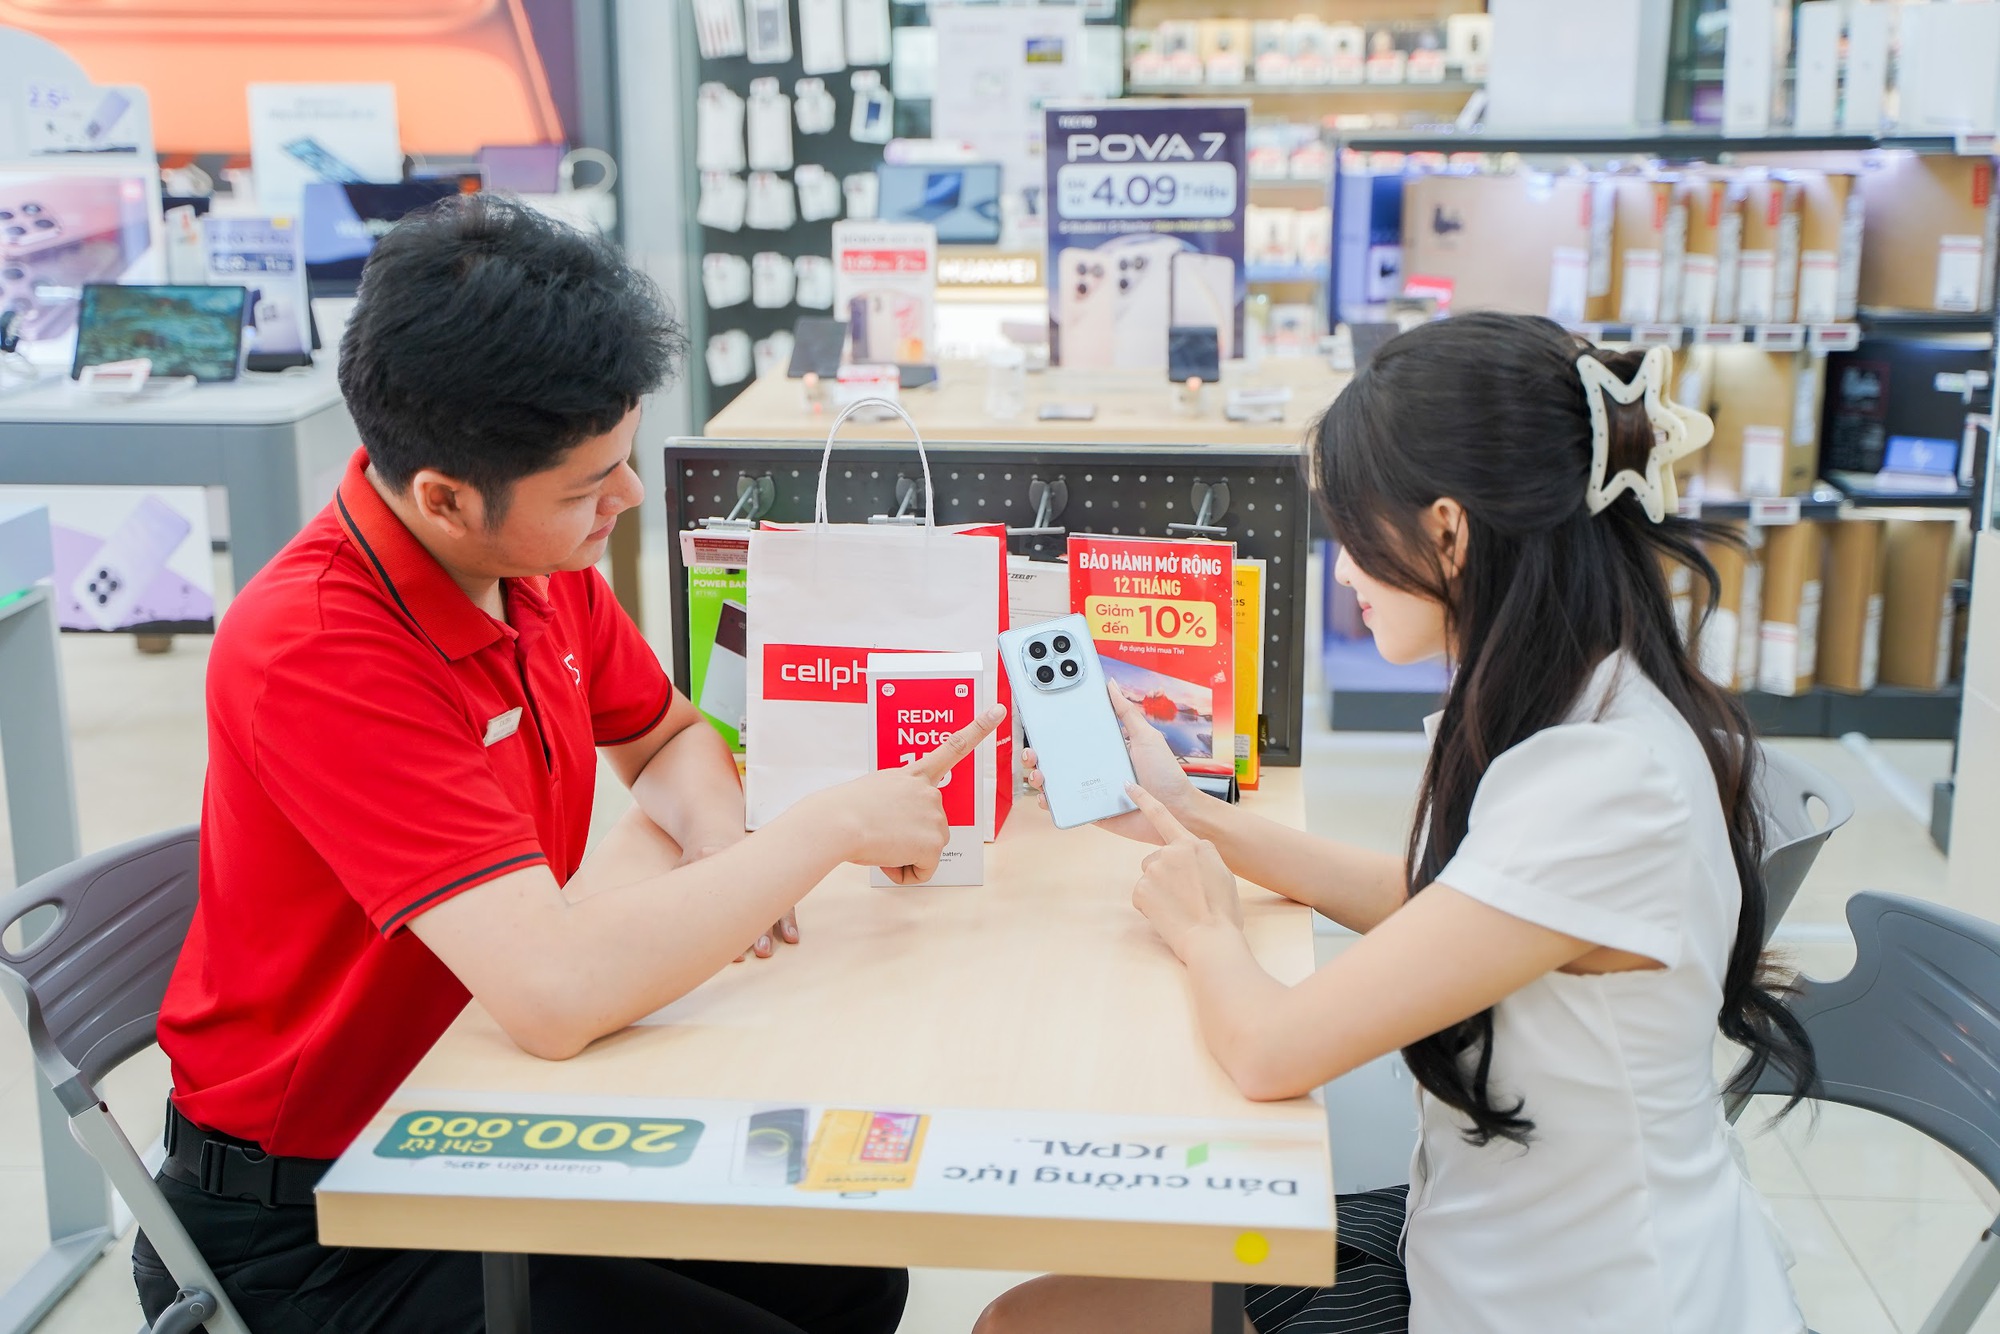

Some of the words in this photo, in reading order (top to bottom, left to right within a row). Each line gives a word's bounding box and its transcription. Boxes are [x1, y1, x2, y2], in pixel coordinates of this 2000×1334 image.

[1066, 132, 1195, 162] POVA
[1199, 132, 1227, 160] 7
[1092, 174, 1177, 207] 4.09
[937, 258, 1038, 284] HUAWEI
[1079, 548, 1109, 570] BẢO
[1112, 551, 1152, 572] HÀNH
[1155, 552, 1179, 573] MỞ
[1181, 554, 1222, 578] RỘNG
[693, 579, 726, 588] POWER
[1114, 577, 1130, 593] 12
[1132, 573, 1181, 596] THÁNG
[1096, 603, 1134, 617] Giảm
[1101, 620, 1129, 635] đến
[1138, 605, 1207, 639] 10%
[1119, 643, 1128, 653] Áp
[1128, 644, 1145, 654] dụng
[1146, 645, 1156, 653] khi
[1173, 647, 1185, 655] Tivi
[897, 709, 954, 724] REDMI
[897, 727, 952, 746] Note
[407, 1116, 686, 1153] 200.000
[399, 1137, 437, 1152] từ
[439, 1139, 494, 1154] Chỉ
[444, 1159, 490, 1170] 49%
[497, 1160, 540, 1172] đến
[545, 1163, 602, 1175] Giảm
[943, 1163, 1018, 1186] lực
[1034, 1165, 1190, 1191] cường
[1206, 1176, 1298, 1196] Dán
